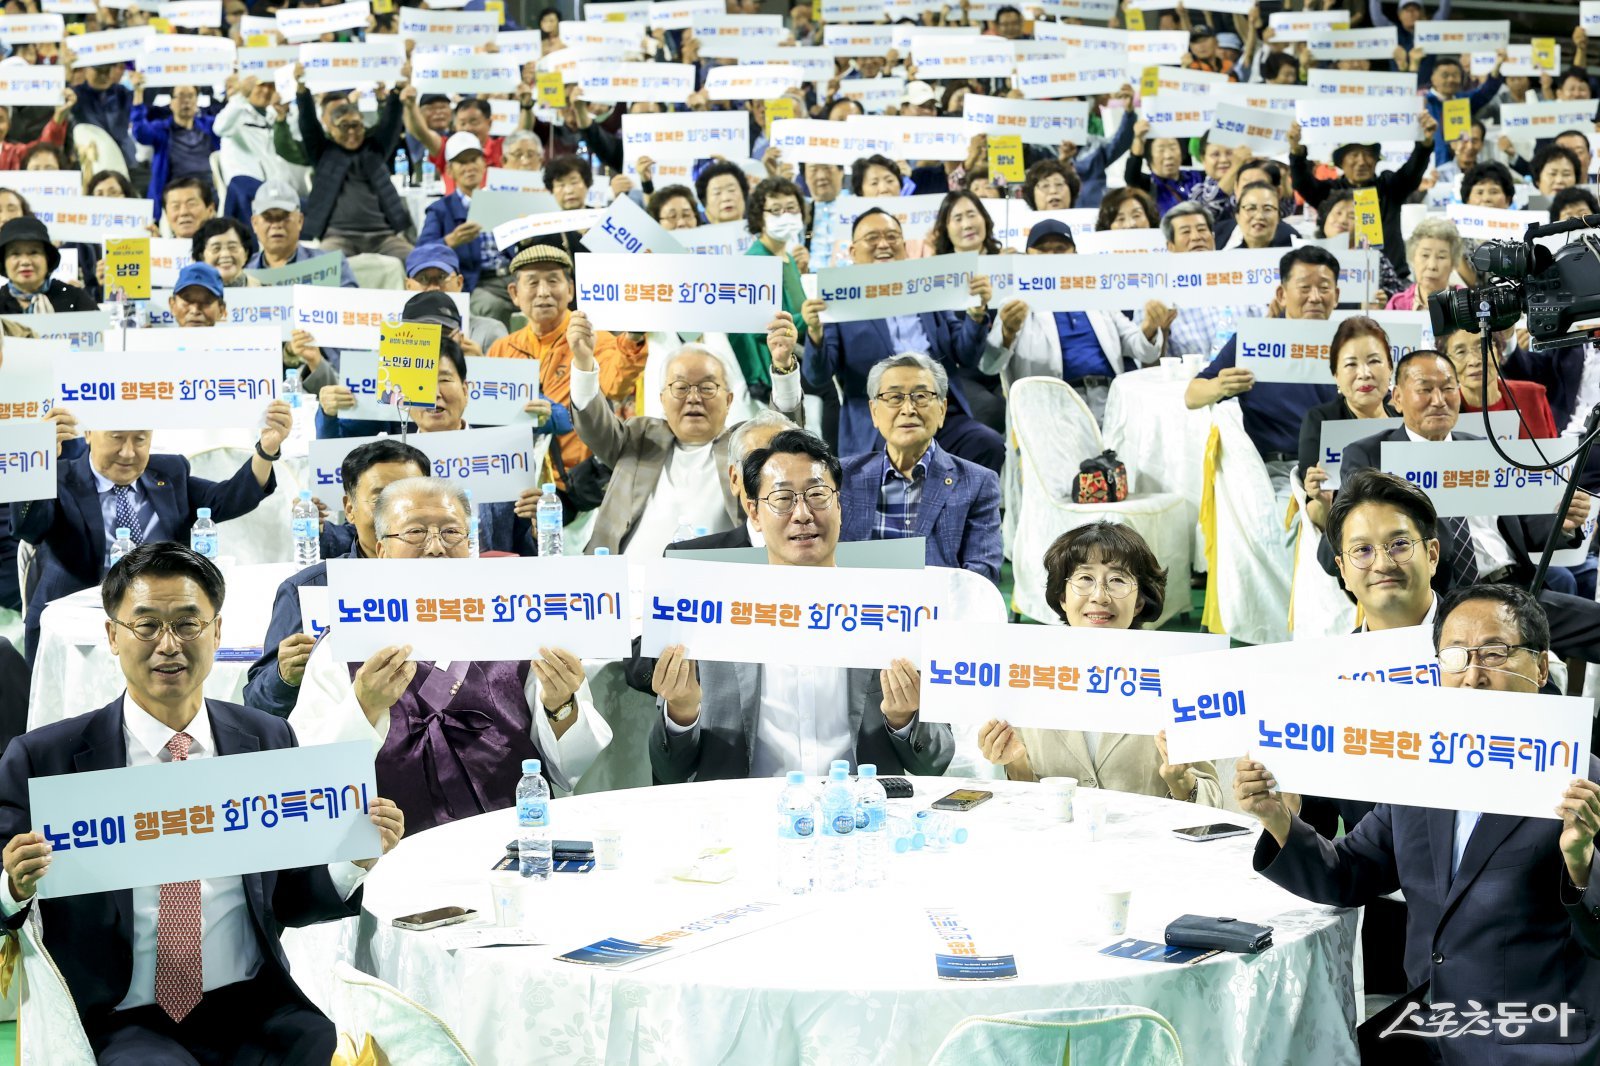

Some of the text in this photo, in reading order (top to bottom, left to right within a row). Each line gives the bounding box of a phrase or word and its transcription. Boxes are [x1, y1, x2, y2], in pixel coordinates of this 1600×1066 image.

[601, 216, 643, 253] 노인이
[116, 264, 140, 277] 남양
[1019, 276, 1056, 291] 노인이
[1060, 276, 1097, 291] 행복한
[1100, 268, 1168, 289] 화성특례시
[1172, 274, 1202, 288] 인이
[1206, 271, 1243, 284] 행복한
[581, 282, 776, 305] 노인이 행복한 화성특례시
[821, 286, 861, 301] 노인이
[865, 282, 904, 299] 행복한
[150, 311, 174, 324] 노인
[299, 308, 338, 324] 노인이
[342, 312, 382, 326] 행복한
[1242, 342, 1286, 358] 노인이
[383, 356, 435, 369] 노인회 이사
[61, 379, 276, 401] 노인이 행복한 화성특례시
[346, 378, 376, 394] 노인
[433, 452, 528, 478] 화성특례시
[1407, 471, 1438, 489] 인이
[1443, 470, 1490, 488] 행복한
[338, 592, 621, 623] 노인이 행복한 화성특례시
[652, 596, 938, 632] 노인이 행복한 화성특례시
[930, 660, 1162, 697] 노인이 행복한 화성특
[1172, 690, 1247, 723] 노인이
[1259, 720, 1579, 774] 노인이 행복한 화성특례시
[43, 782, 369, 852] 노인이 행복한 화성특례시
